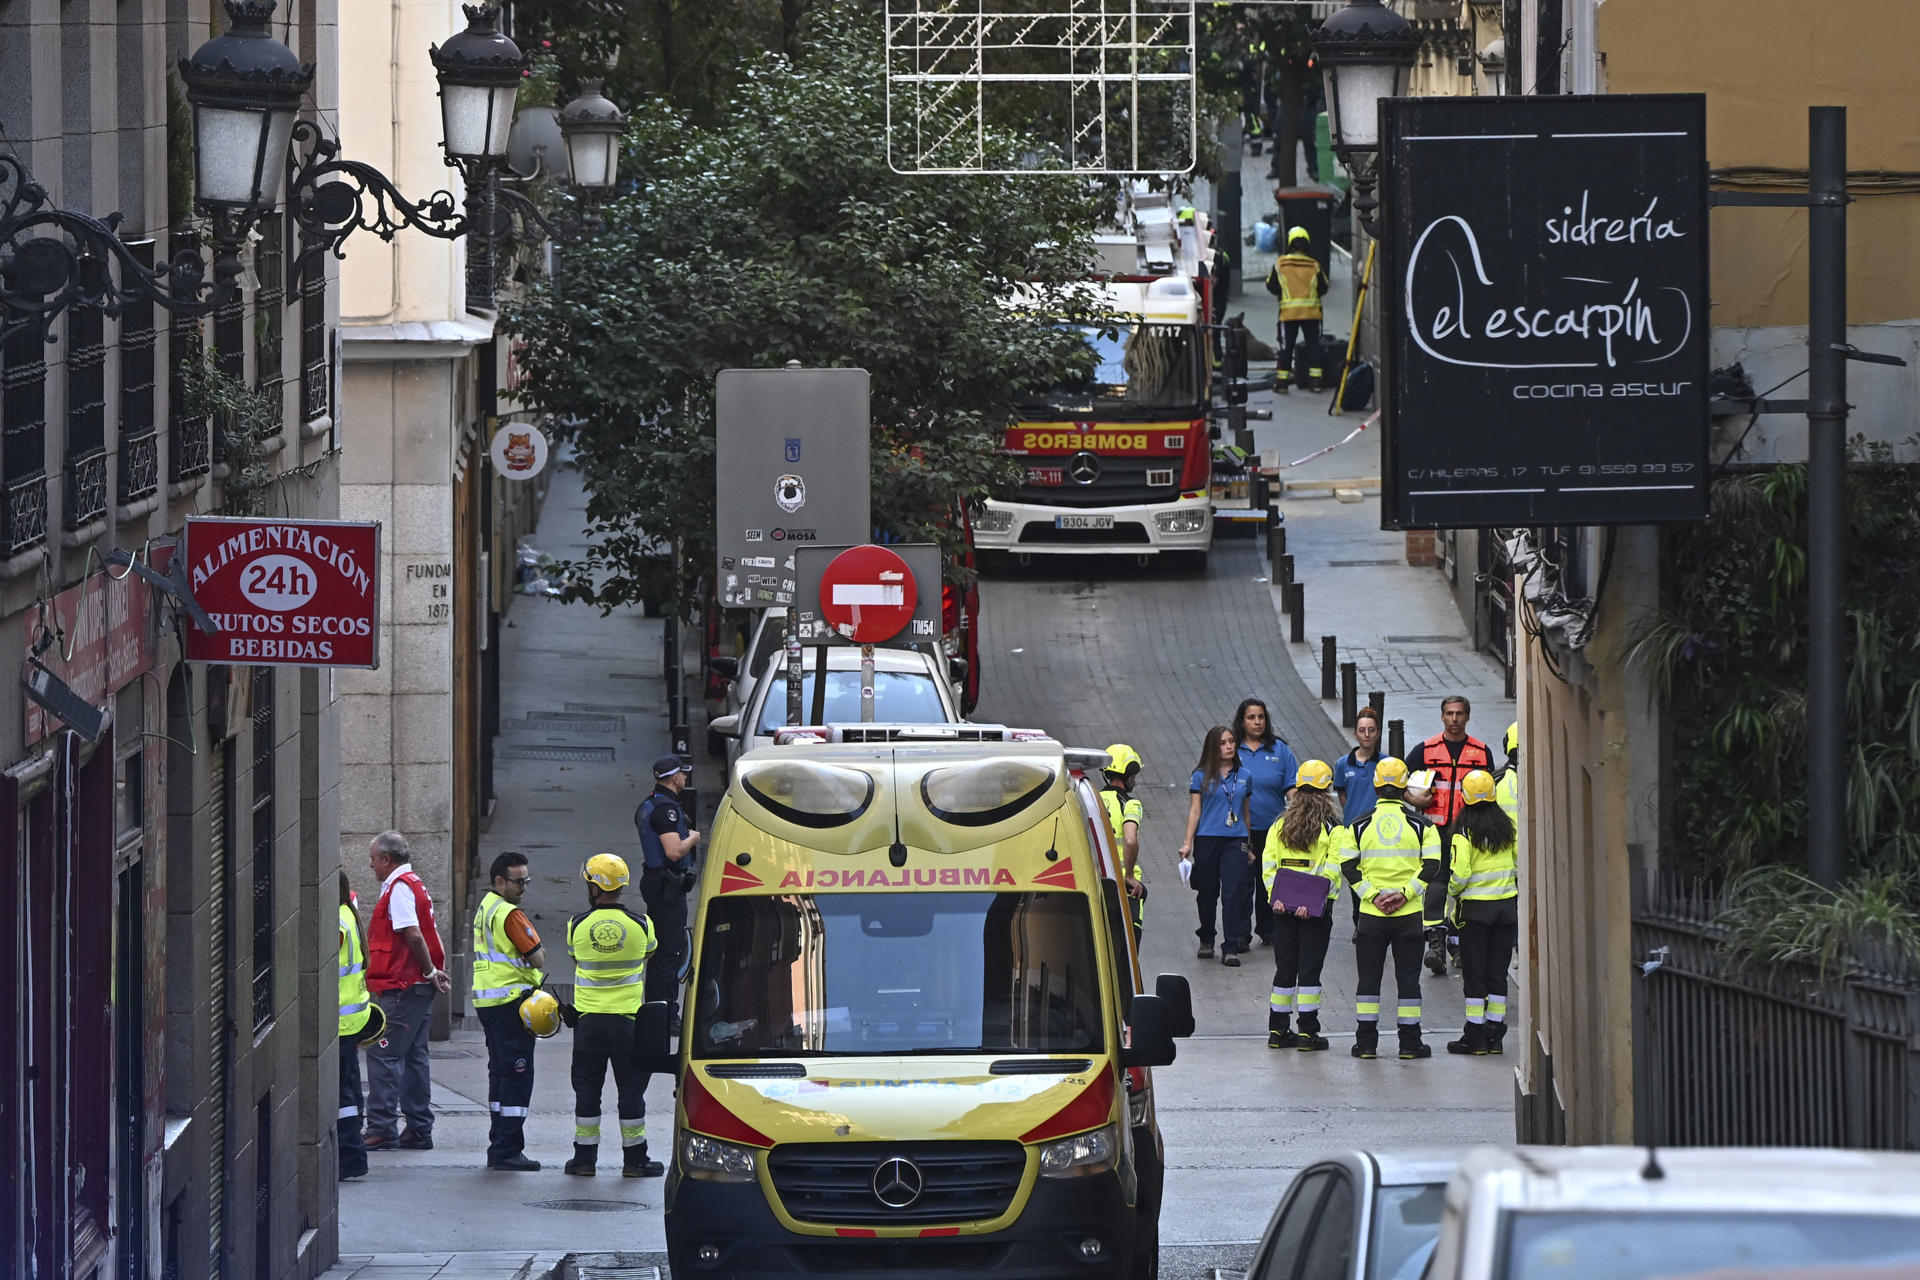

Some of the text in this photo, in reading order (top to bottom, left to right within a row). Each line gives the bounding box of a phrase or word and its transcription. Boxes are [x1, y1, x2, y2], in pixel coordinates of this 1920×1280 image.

[1545, 189, 1688, 246] sidrería
[1432, 249, 1662, 367] el escarpín
[1150, 326, 1181, 337] 1717
[1513, 382, 1692, 399] cocina astur
[1540, 465, 1571, 475] TLF
[1671, 463, 1695, 473] 57
[1063, 517, 1088, 528] 9304
[787, 533, 817, 541] MOSA
[191, 525, 371, 599] ALIMENTACIÓN
[248, 565, 310, 596] 24h
[432, 584, 447, 598] EN
[194, 613, 370, 636] RUTOS SECOS
[912, 619, 935, 635] TM54
[229, 638, 334, 660] BEBIDAS
